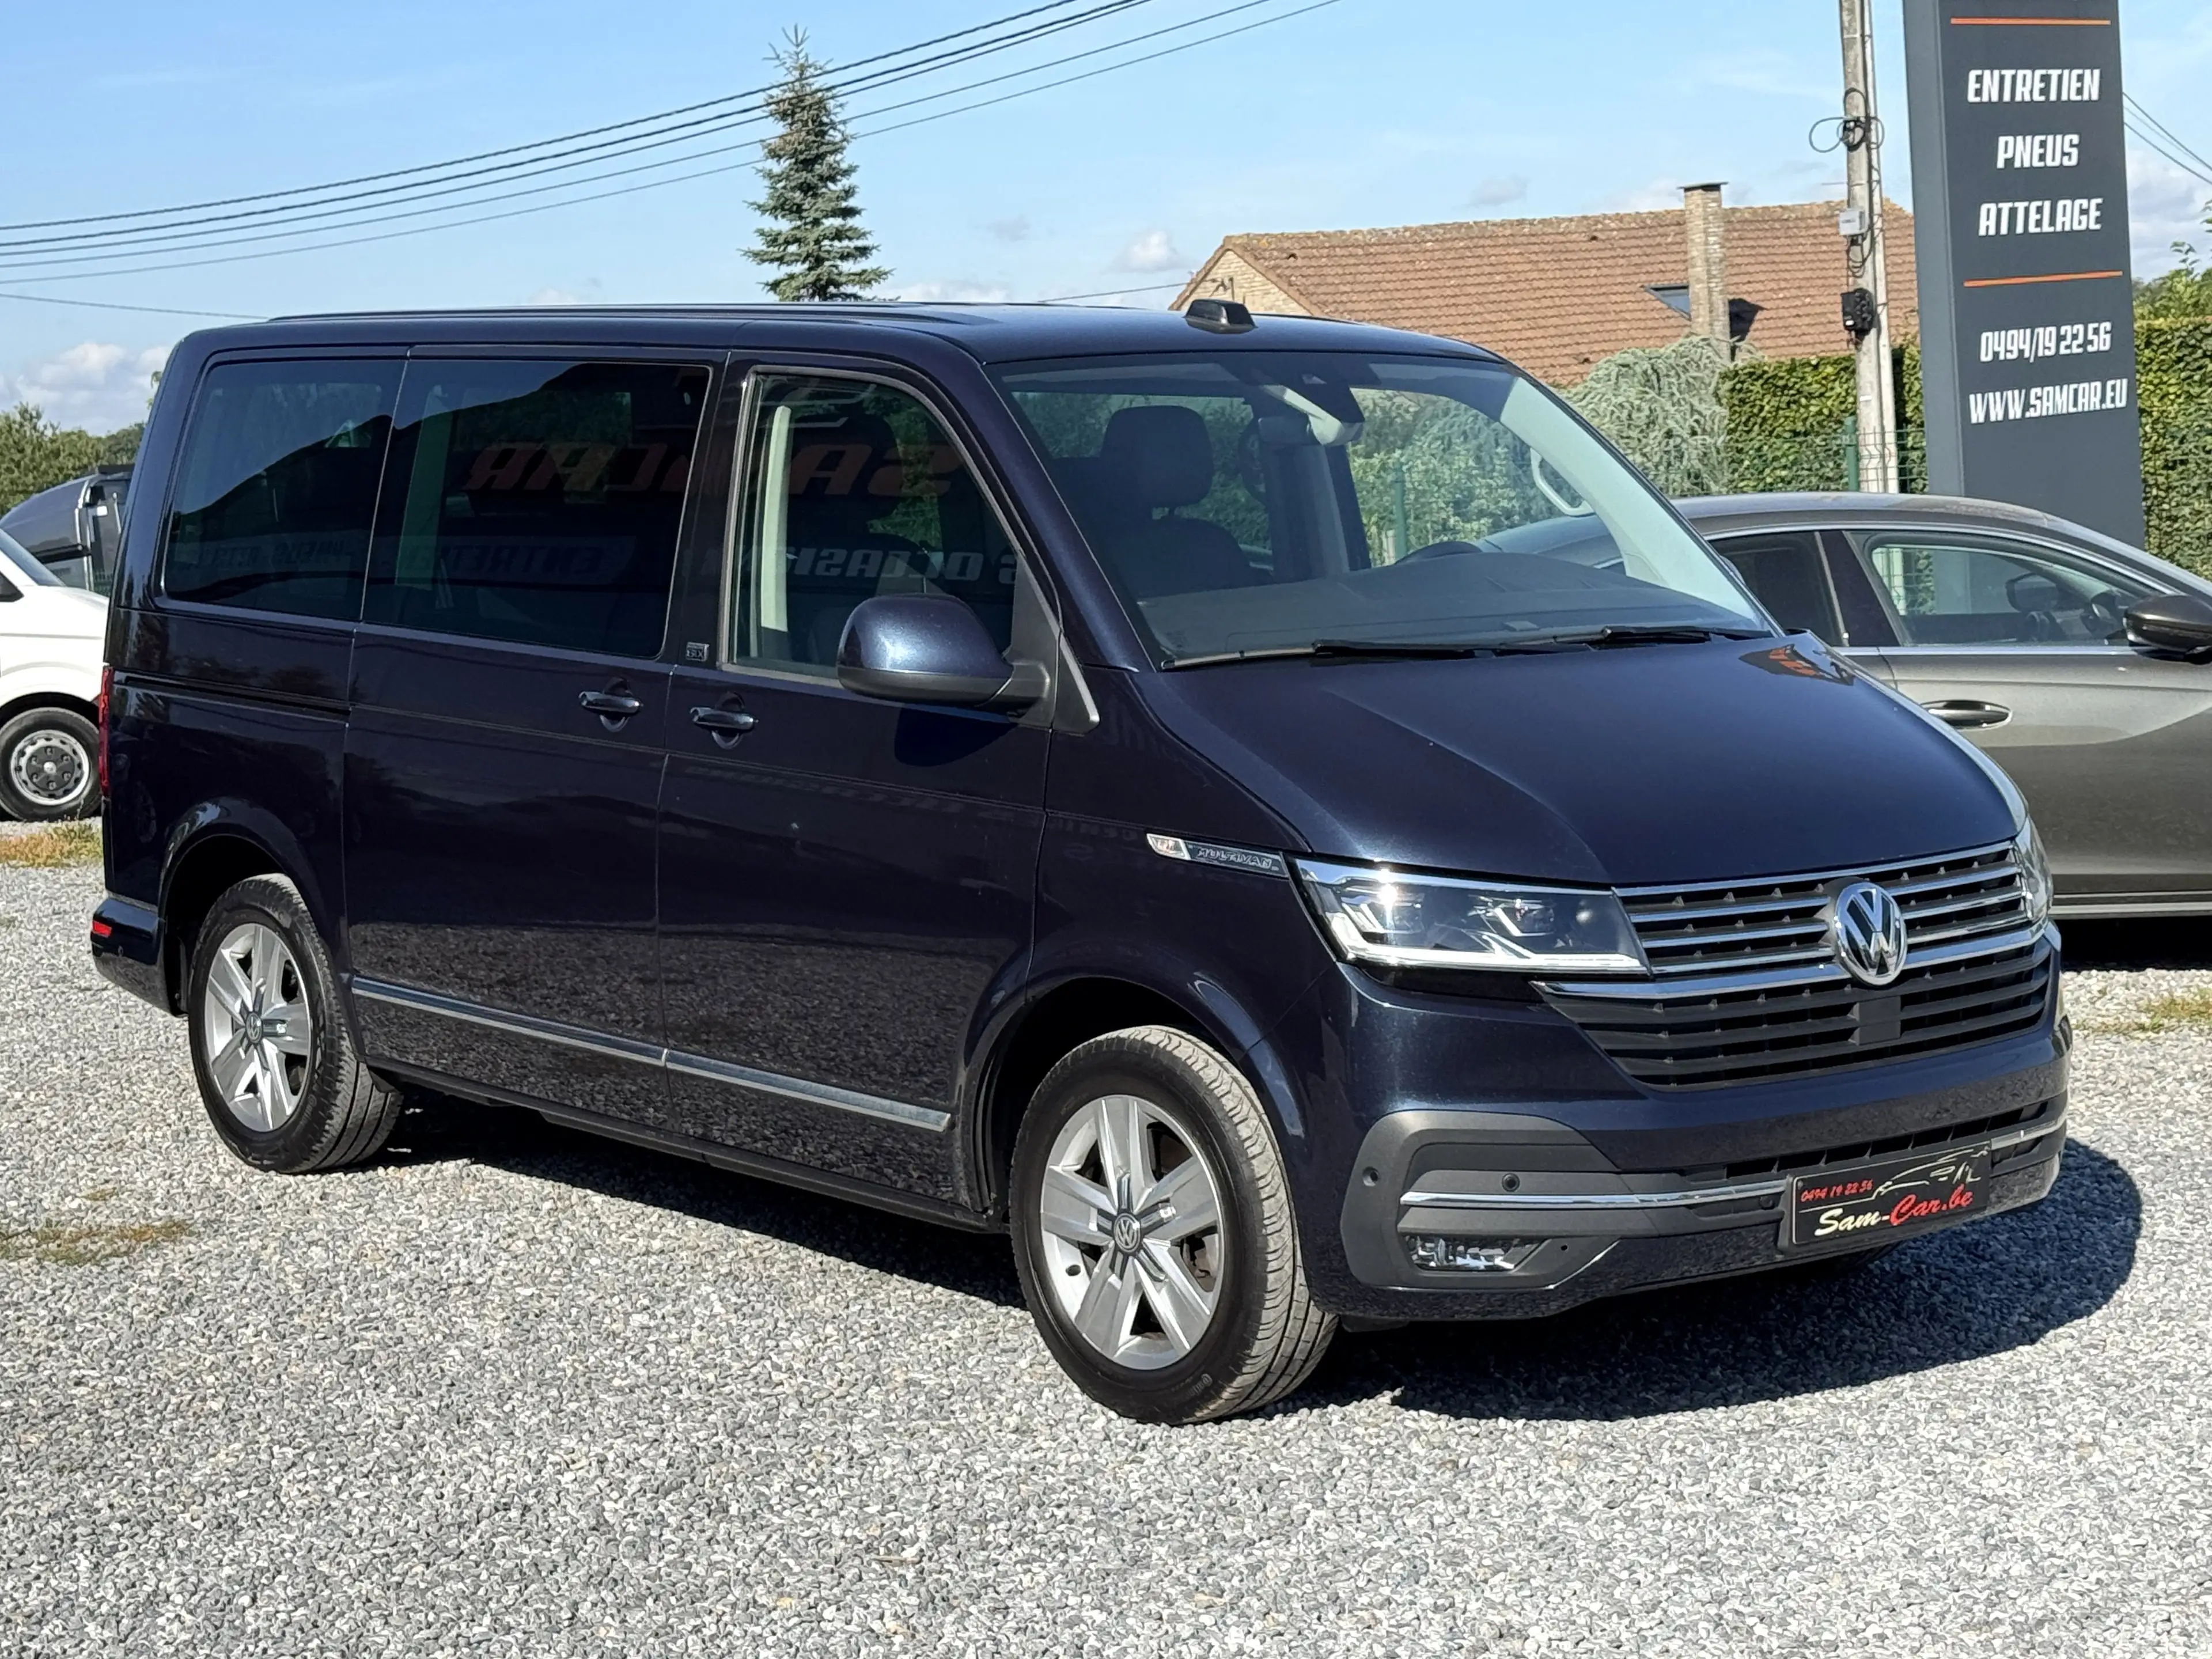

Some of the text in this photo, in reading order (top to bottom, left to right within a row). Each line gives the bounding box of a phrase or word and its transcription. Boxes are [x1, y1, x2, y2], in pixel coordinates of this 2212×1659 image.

[1967, 68, 2101, 103] ENTRETIEN
[1997, 134, 2080, 169] PNEUS
[1978, 198, 2103, 237] ATTELAGE
[1980, 321, 2112, 363] 0494/19 22 56
[1969, 378, 2128, 424] WWW.SAMCAR.EU
[1814, 1184, 1974, 1236] Sam-Car.be
